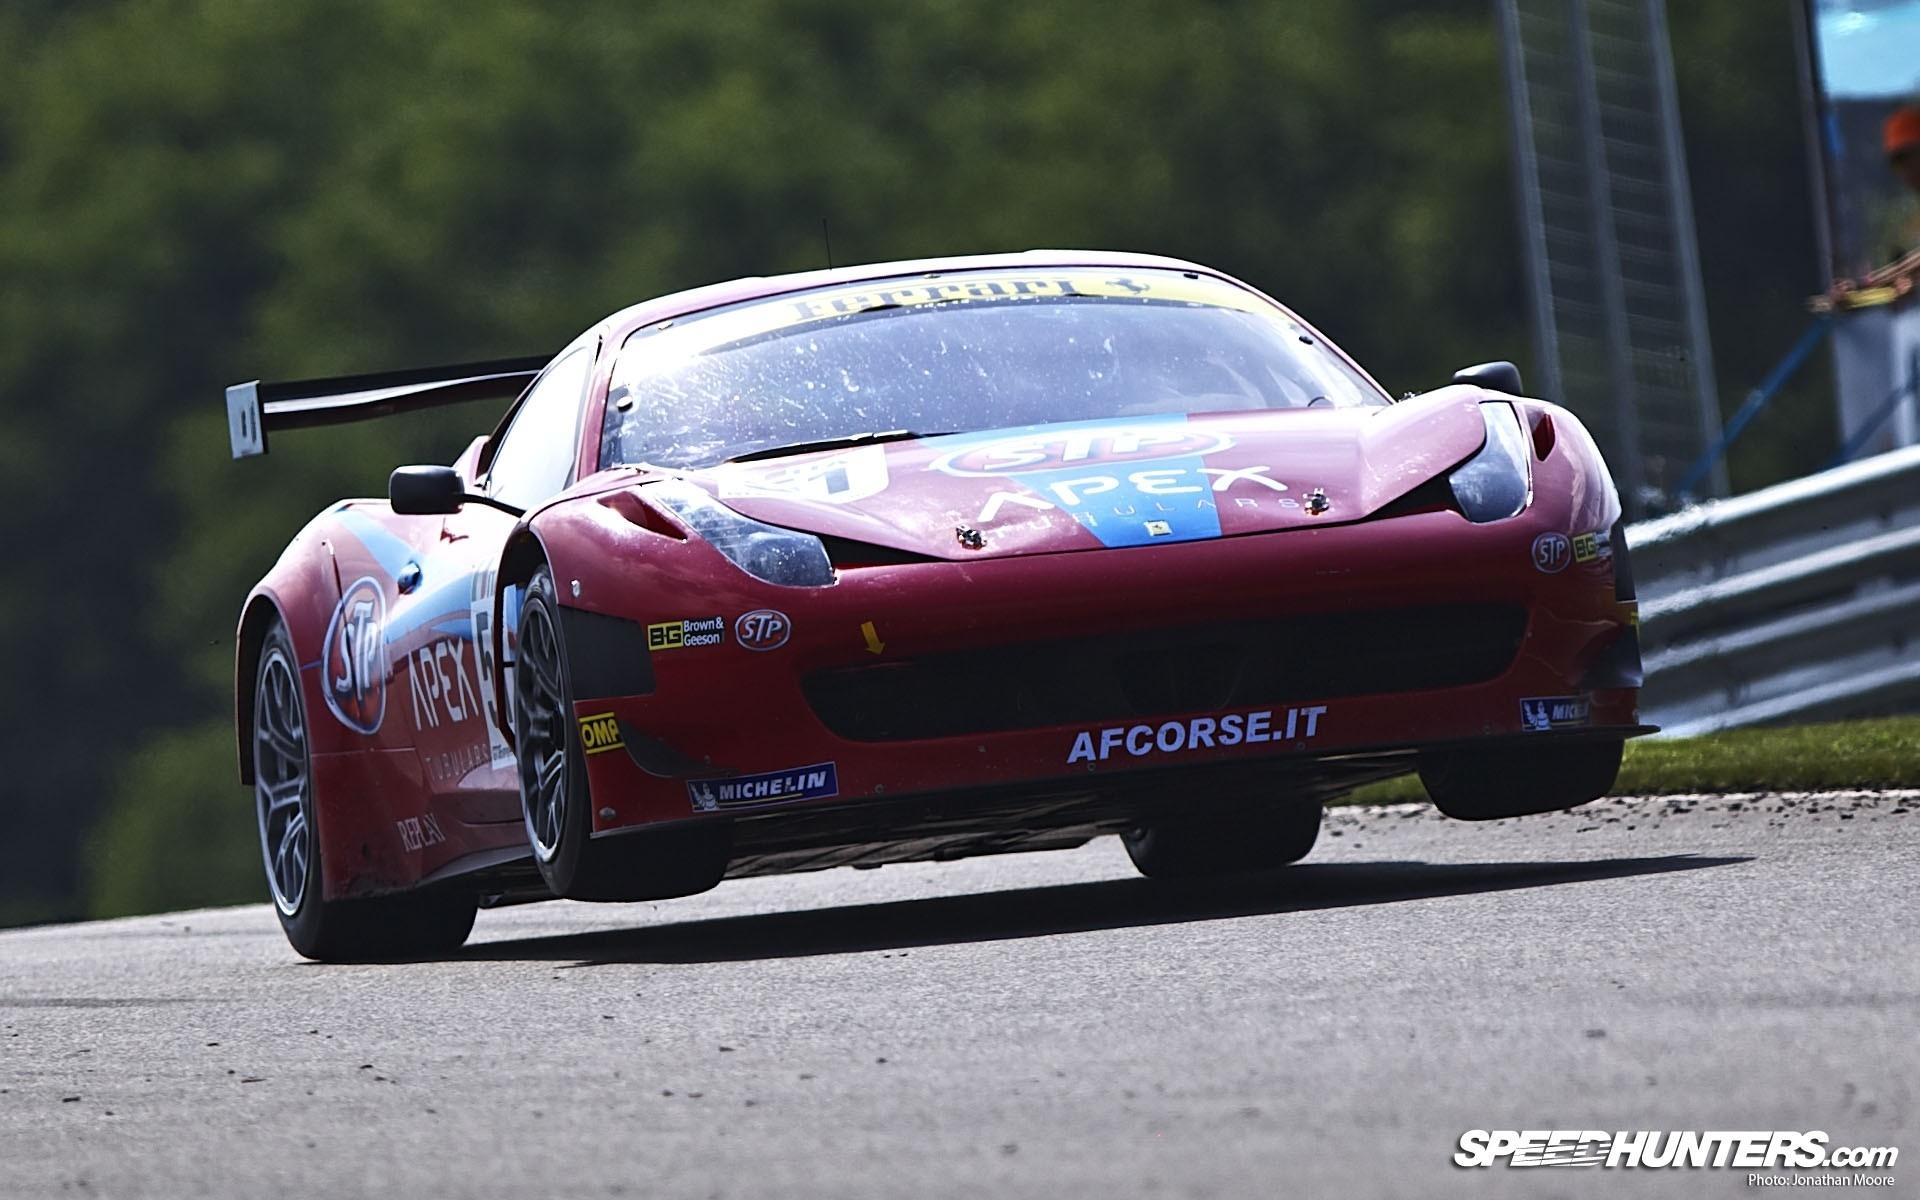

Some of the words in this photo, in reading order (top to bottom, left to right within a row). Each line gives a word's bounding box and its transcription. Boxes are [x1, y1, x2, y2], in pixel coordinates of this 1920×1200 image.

[794, 278, 1078, 321] Ferrari
[984, 430, 1188, 470] STP
[977, 465, 1289, 523] APEX
[1538, 536, 1566, 565] STP
[684, 618, 715, 632] Brown
[715, 617, 724, 630] &
[684, 631, 721, 647] Geeson
[741, 612, 783, 642] STP
[335, 600, 377, 698] STP
[407, 638, 479, 731] APEX
[1066, 706, 1328, 764] AFCORSE.IT
[719, 771, 827, 800] MICHELIN
[396, 813, 446, 852] REPLAY
